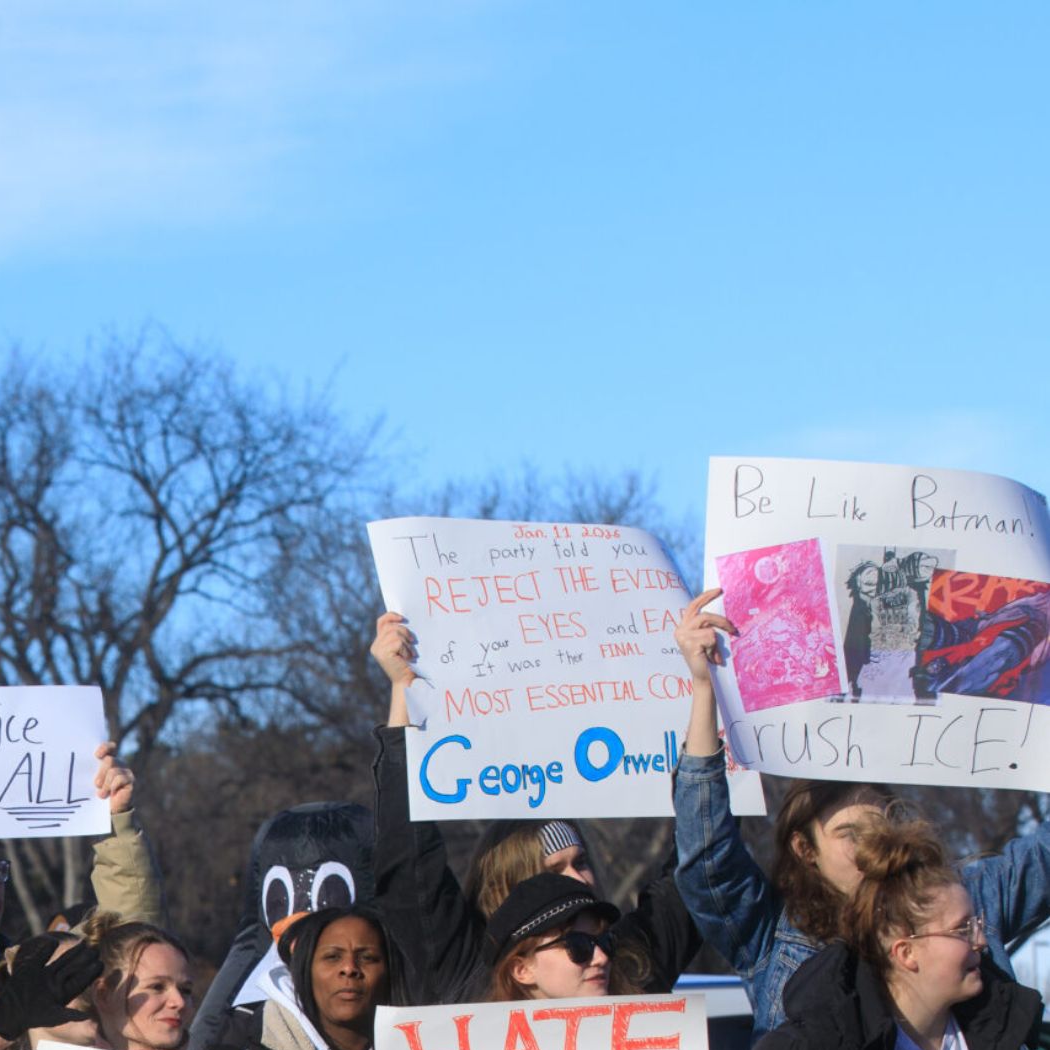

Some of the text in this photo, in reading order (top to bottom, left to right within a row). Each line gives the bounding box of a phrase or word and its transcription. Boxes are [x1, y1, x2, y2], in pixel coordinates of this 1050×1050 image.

[734, 464, 1035, 537] Be Like Batman!
[392, 533, 648, 569] The party told you
[513, 525, 547, 540] Jan.
[553, 525, 571, 539] 11
[424, 566, 687, 616] REJECT THE EVIDE
[440, 640, 456, 664] of
[518, 612, 587, 644] EYES
[606, 612, 639, 635] and
[472, 662, 495, 678] It
[507, 658, 542, 673] was
[599, 641, 645, 659] FINAL
[661, 647, 682, 655] an
[445, 687, 514, 723] MOST
[527, 679, 643, 712] ESSENTIAL
[901, 703, 1034, 776] ICE!
[419, 726, 678, 808] George Orwell
